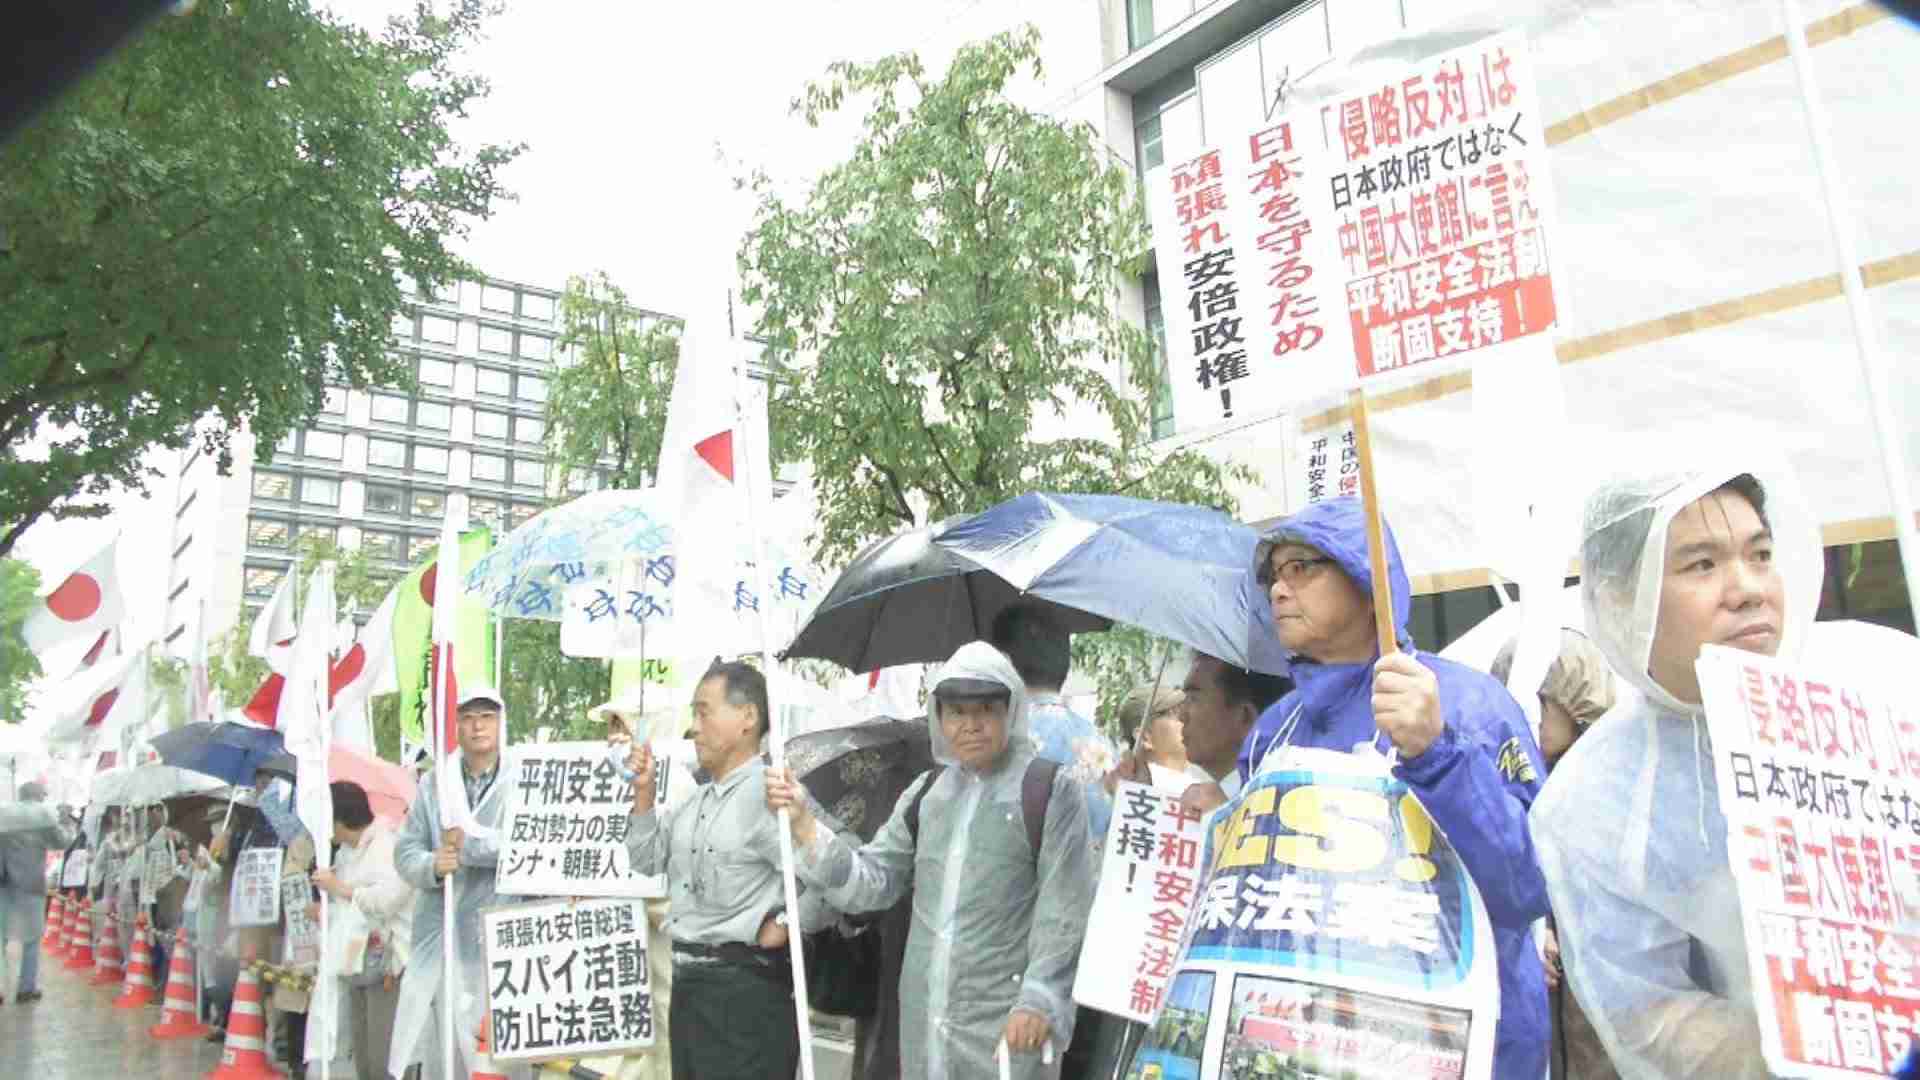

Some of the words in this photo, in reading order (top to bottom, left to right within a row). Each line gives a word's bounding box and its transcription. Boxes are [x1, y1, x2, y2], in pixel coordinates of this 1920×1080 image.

[1331, 112, 1527, 210] 日本政府ではなく
[1248, 122, 1324, 357] 日本を守るため
[1170, 149, 1250, 417] 頑張れ安倍政権！
[507, 849, 633, 880] シナ・朝鮮人
[511, 813, 634, 844] 反対勢力の実
[1116, 789, 1160, 893] 支持！
[496, 904, 636, 949] 頑張れ安倍総理
[1129, 795, 1203, 1014] 平和安全法制
[491, 940, 649, 1000] スパイ活動
[492, 991, 652, 1054] 防止法急務
